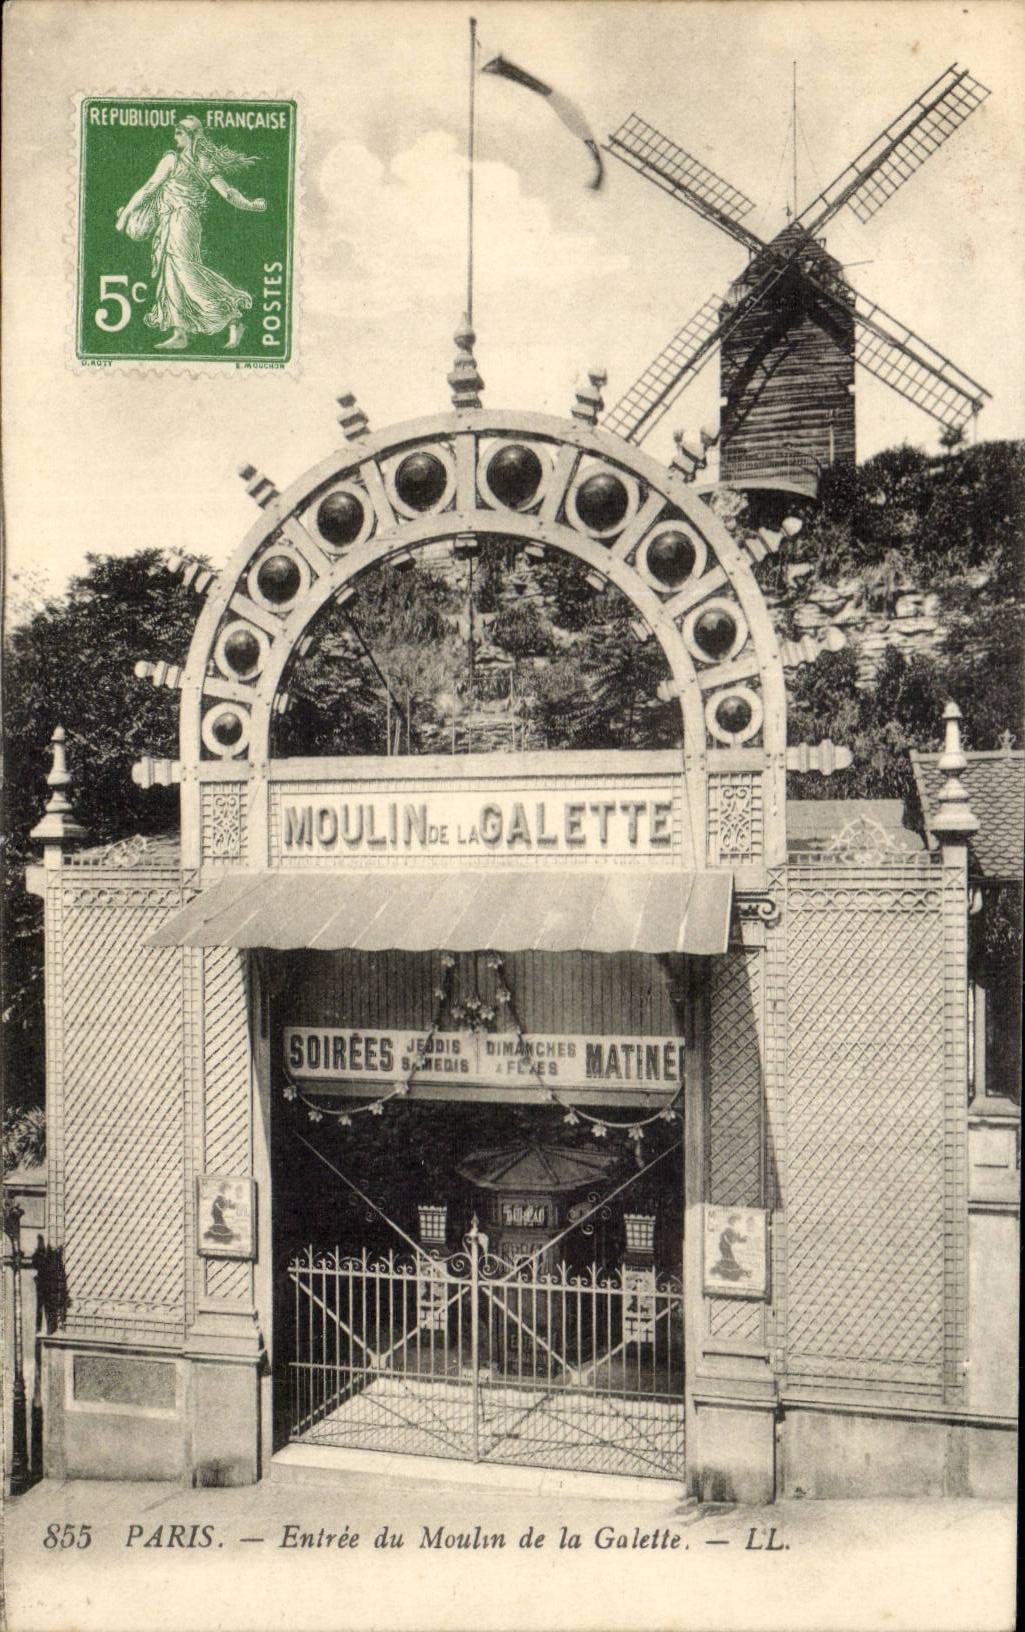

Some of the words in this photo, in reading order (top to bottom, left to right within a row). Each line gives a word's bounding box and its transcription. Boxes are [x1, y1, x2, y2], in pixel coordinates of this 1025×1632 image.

[90, 107, 176, 128] REPUBLIQUE
[206, 110, 287, 130] FRANÇAISE
[262, 261, 283, 347] POSTES
[283, 802, 428, 849] MOULIN
[428, 824, 450, 845] DE
[457, 824, 479, 845] LA
[478, 800, 672, 849] GALETTE
[290, 1032, 394, 1073] SOIRÉES
